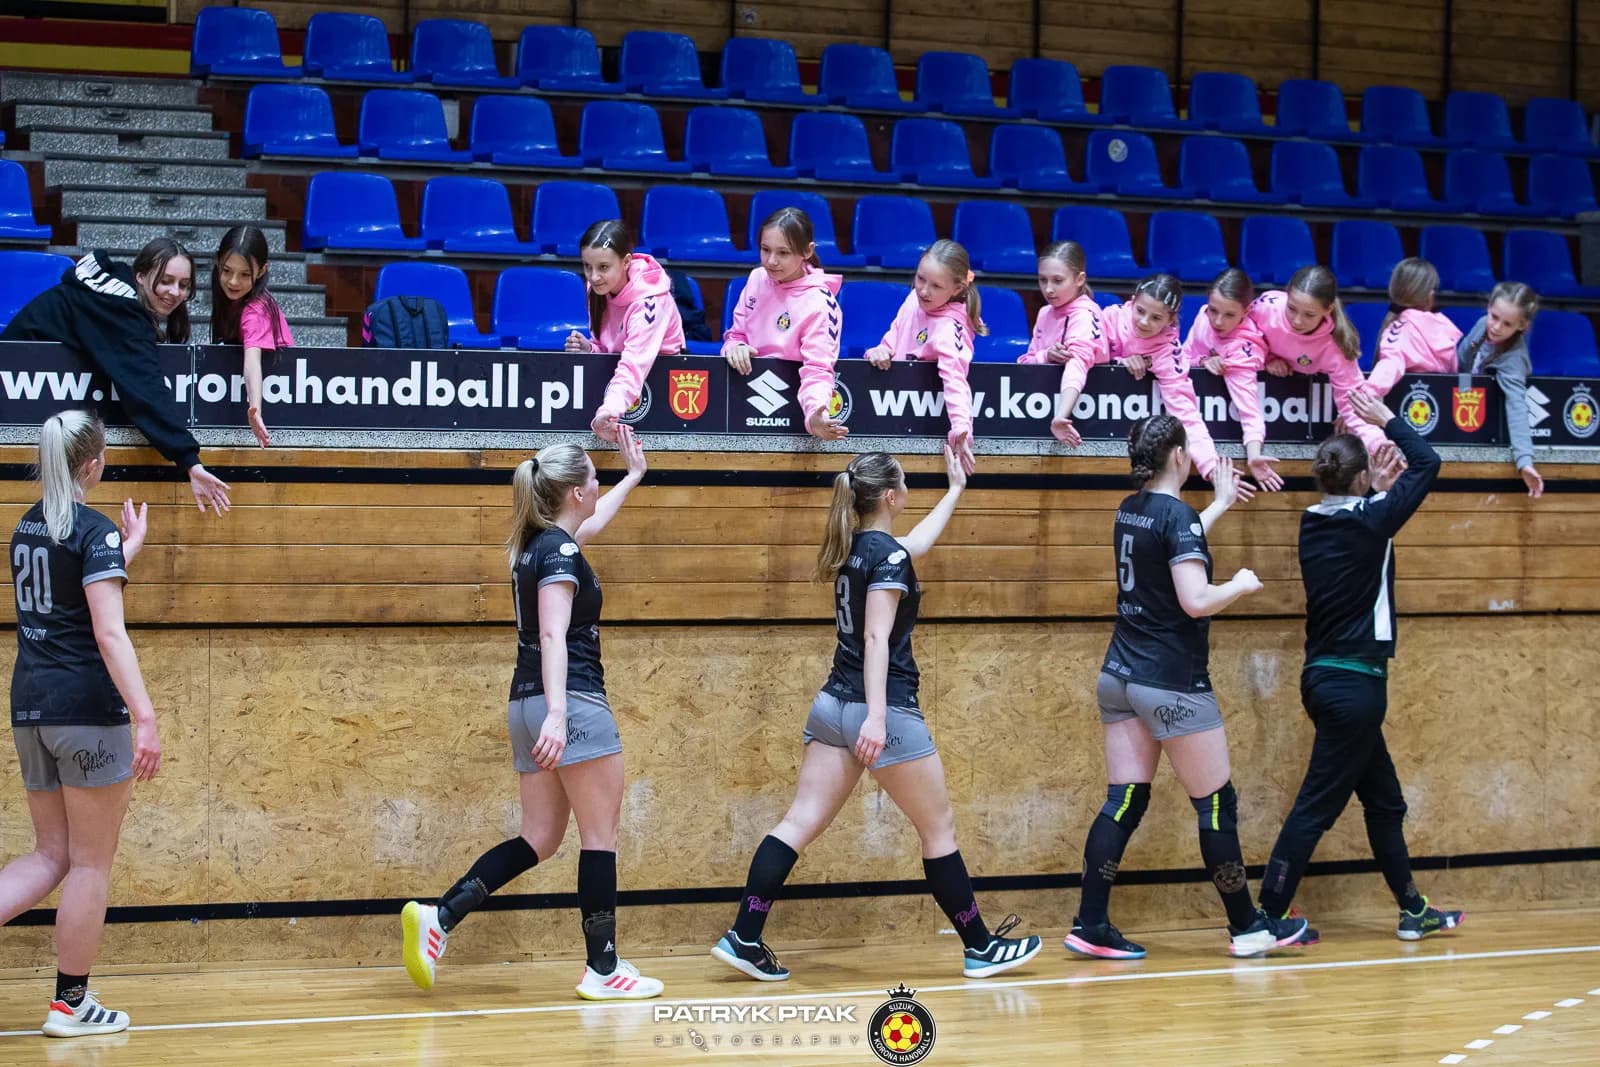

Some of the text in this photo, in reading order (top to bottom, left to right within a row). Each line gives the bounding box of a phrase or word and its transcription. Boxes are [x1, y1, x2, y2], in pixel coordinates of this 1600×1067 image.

[673, 389, 701, 414] CK
[745, 417, 790, 427] SUZUKI
[1455, 404, 1480, 428] CK
[1119, 533, 1135, 592] 5
[14, 543, 53, 614] 20
